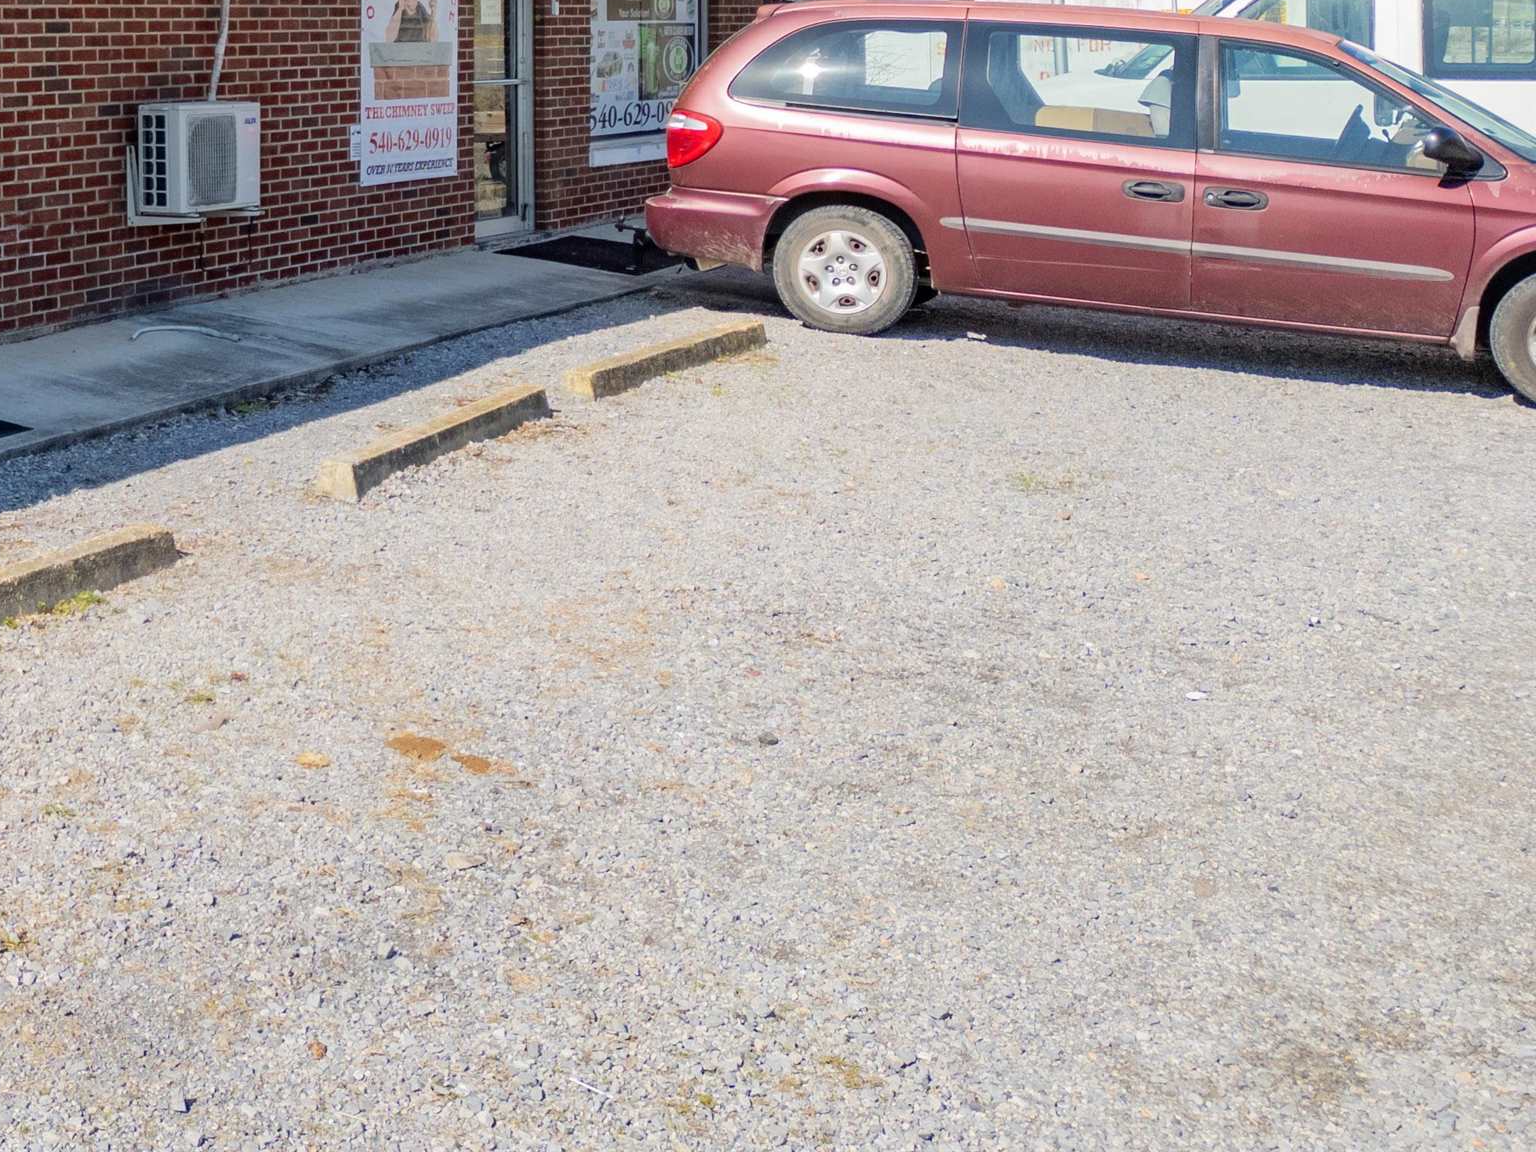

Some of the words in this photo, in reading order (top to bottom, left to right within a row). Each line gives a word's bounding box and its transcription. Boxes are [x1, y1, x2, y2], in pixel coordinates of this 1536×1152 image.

[365, 106, 384, 120] THE
[385, 104, 429, 119] CHIMNEY
[430, 103, 455, 116] SWEEP
[591, 101, 673, 130] 540-629-09
[369, 128, 452, 154] 540-629-0919
[366, 165, 385, 176] OVER
[415, 158, 454, 171] EXPERIENCE
